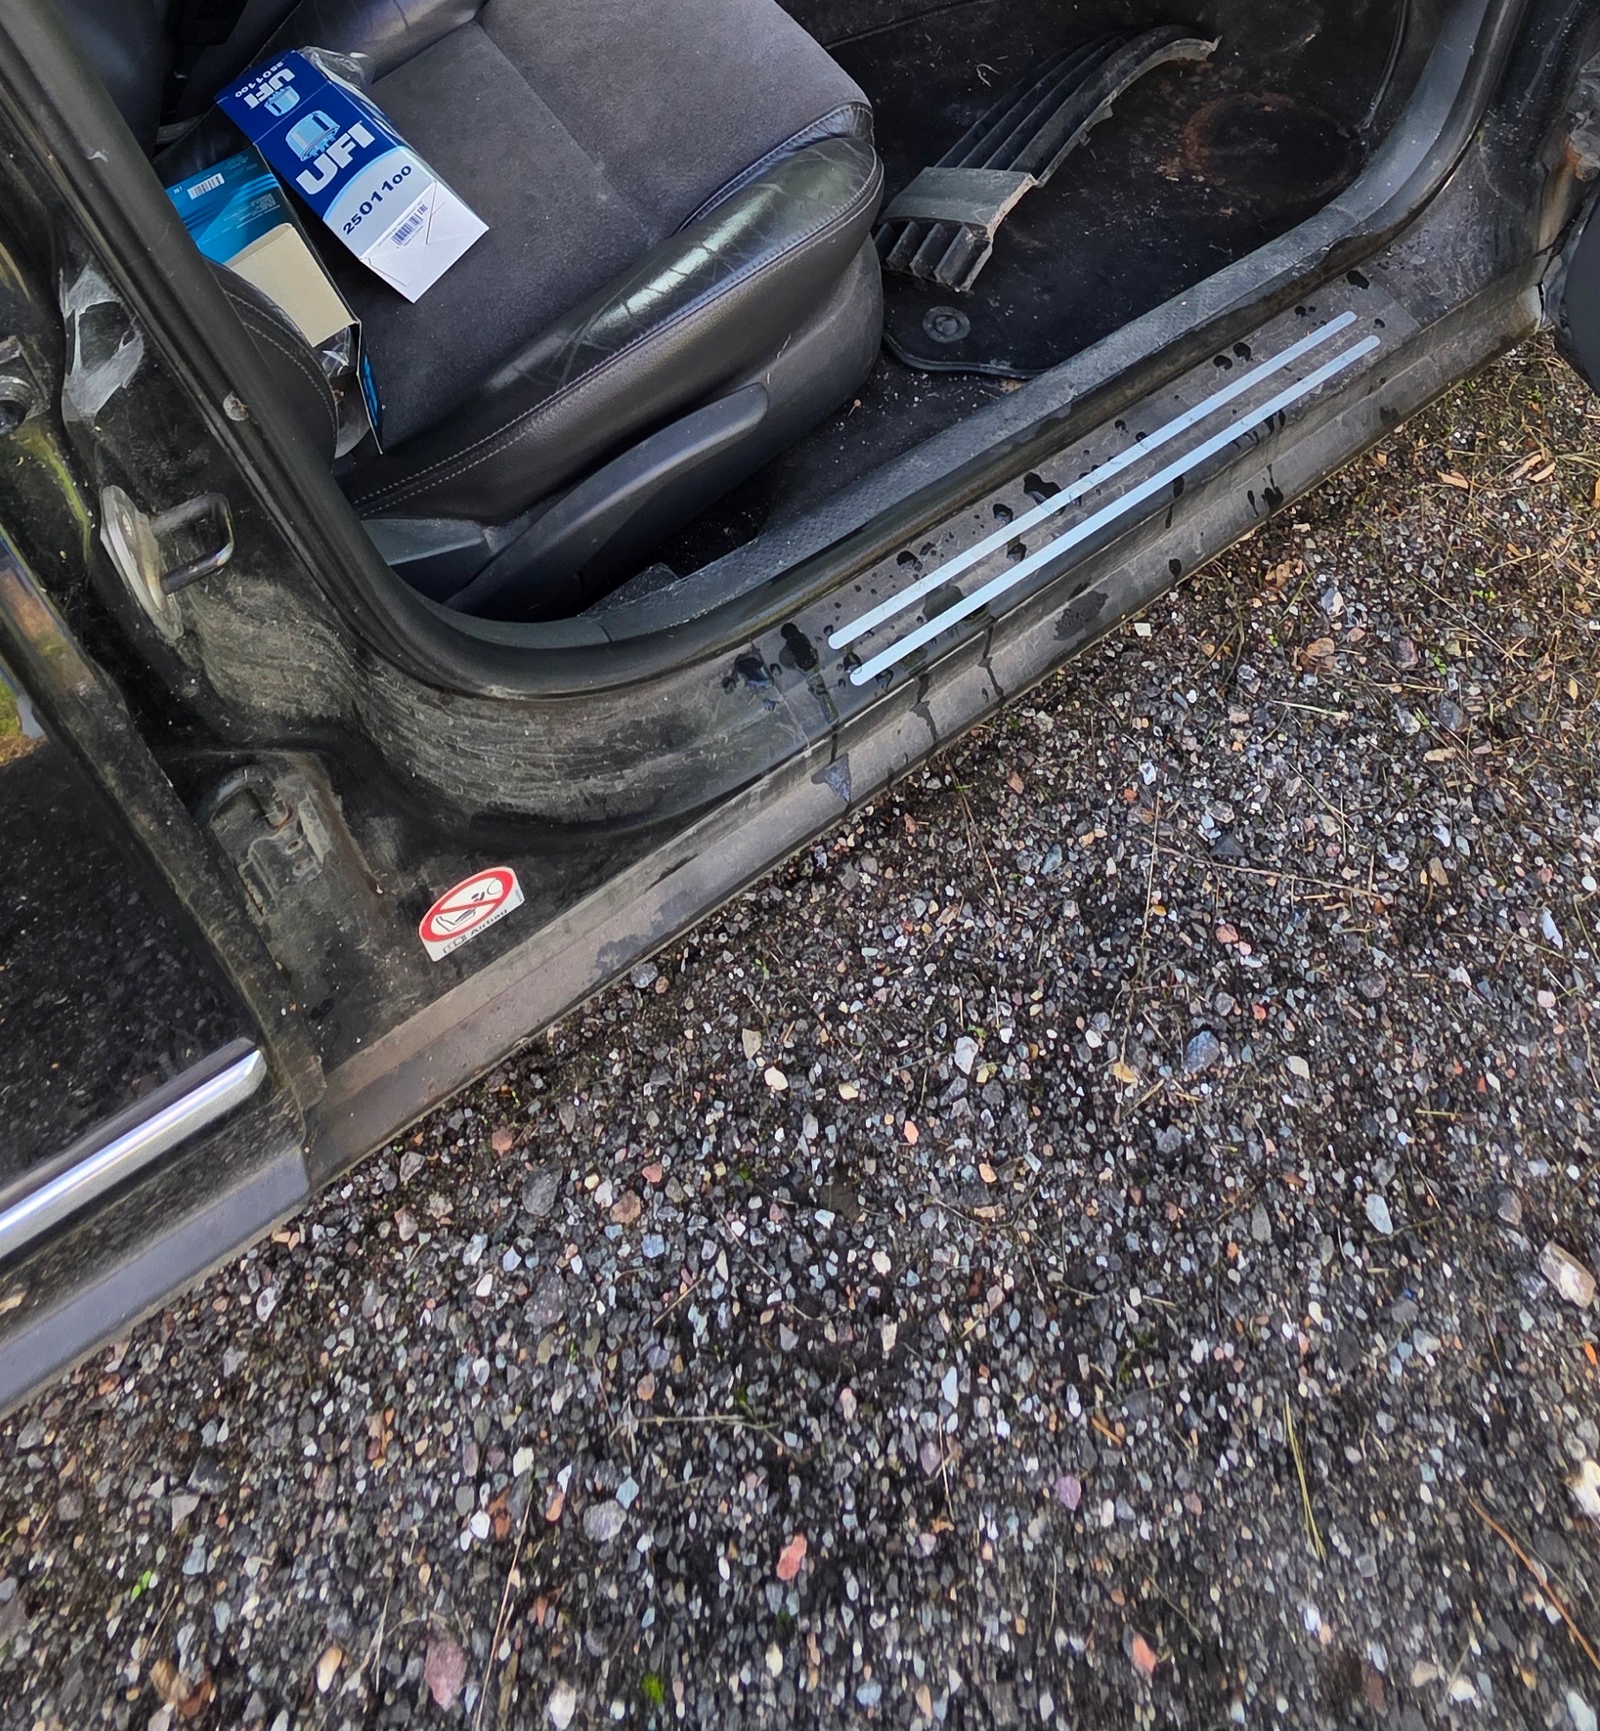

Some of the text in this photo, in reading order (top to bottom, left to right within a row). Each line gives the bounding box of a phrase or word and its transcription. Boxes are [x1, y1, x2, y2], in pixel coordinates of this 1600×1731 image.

[243, 68, 296, 109] UFI
[296, 121, 375, 195] UFI
[342, 165, 412, 235] 2501100
[470, 909, 508, 936] Airbag
